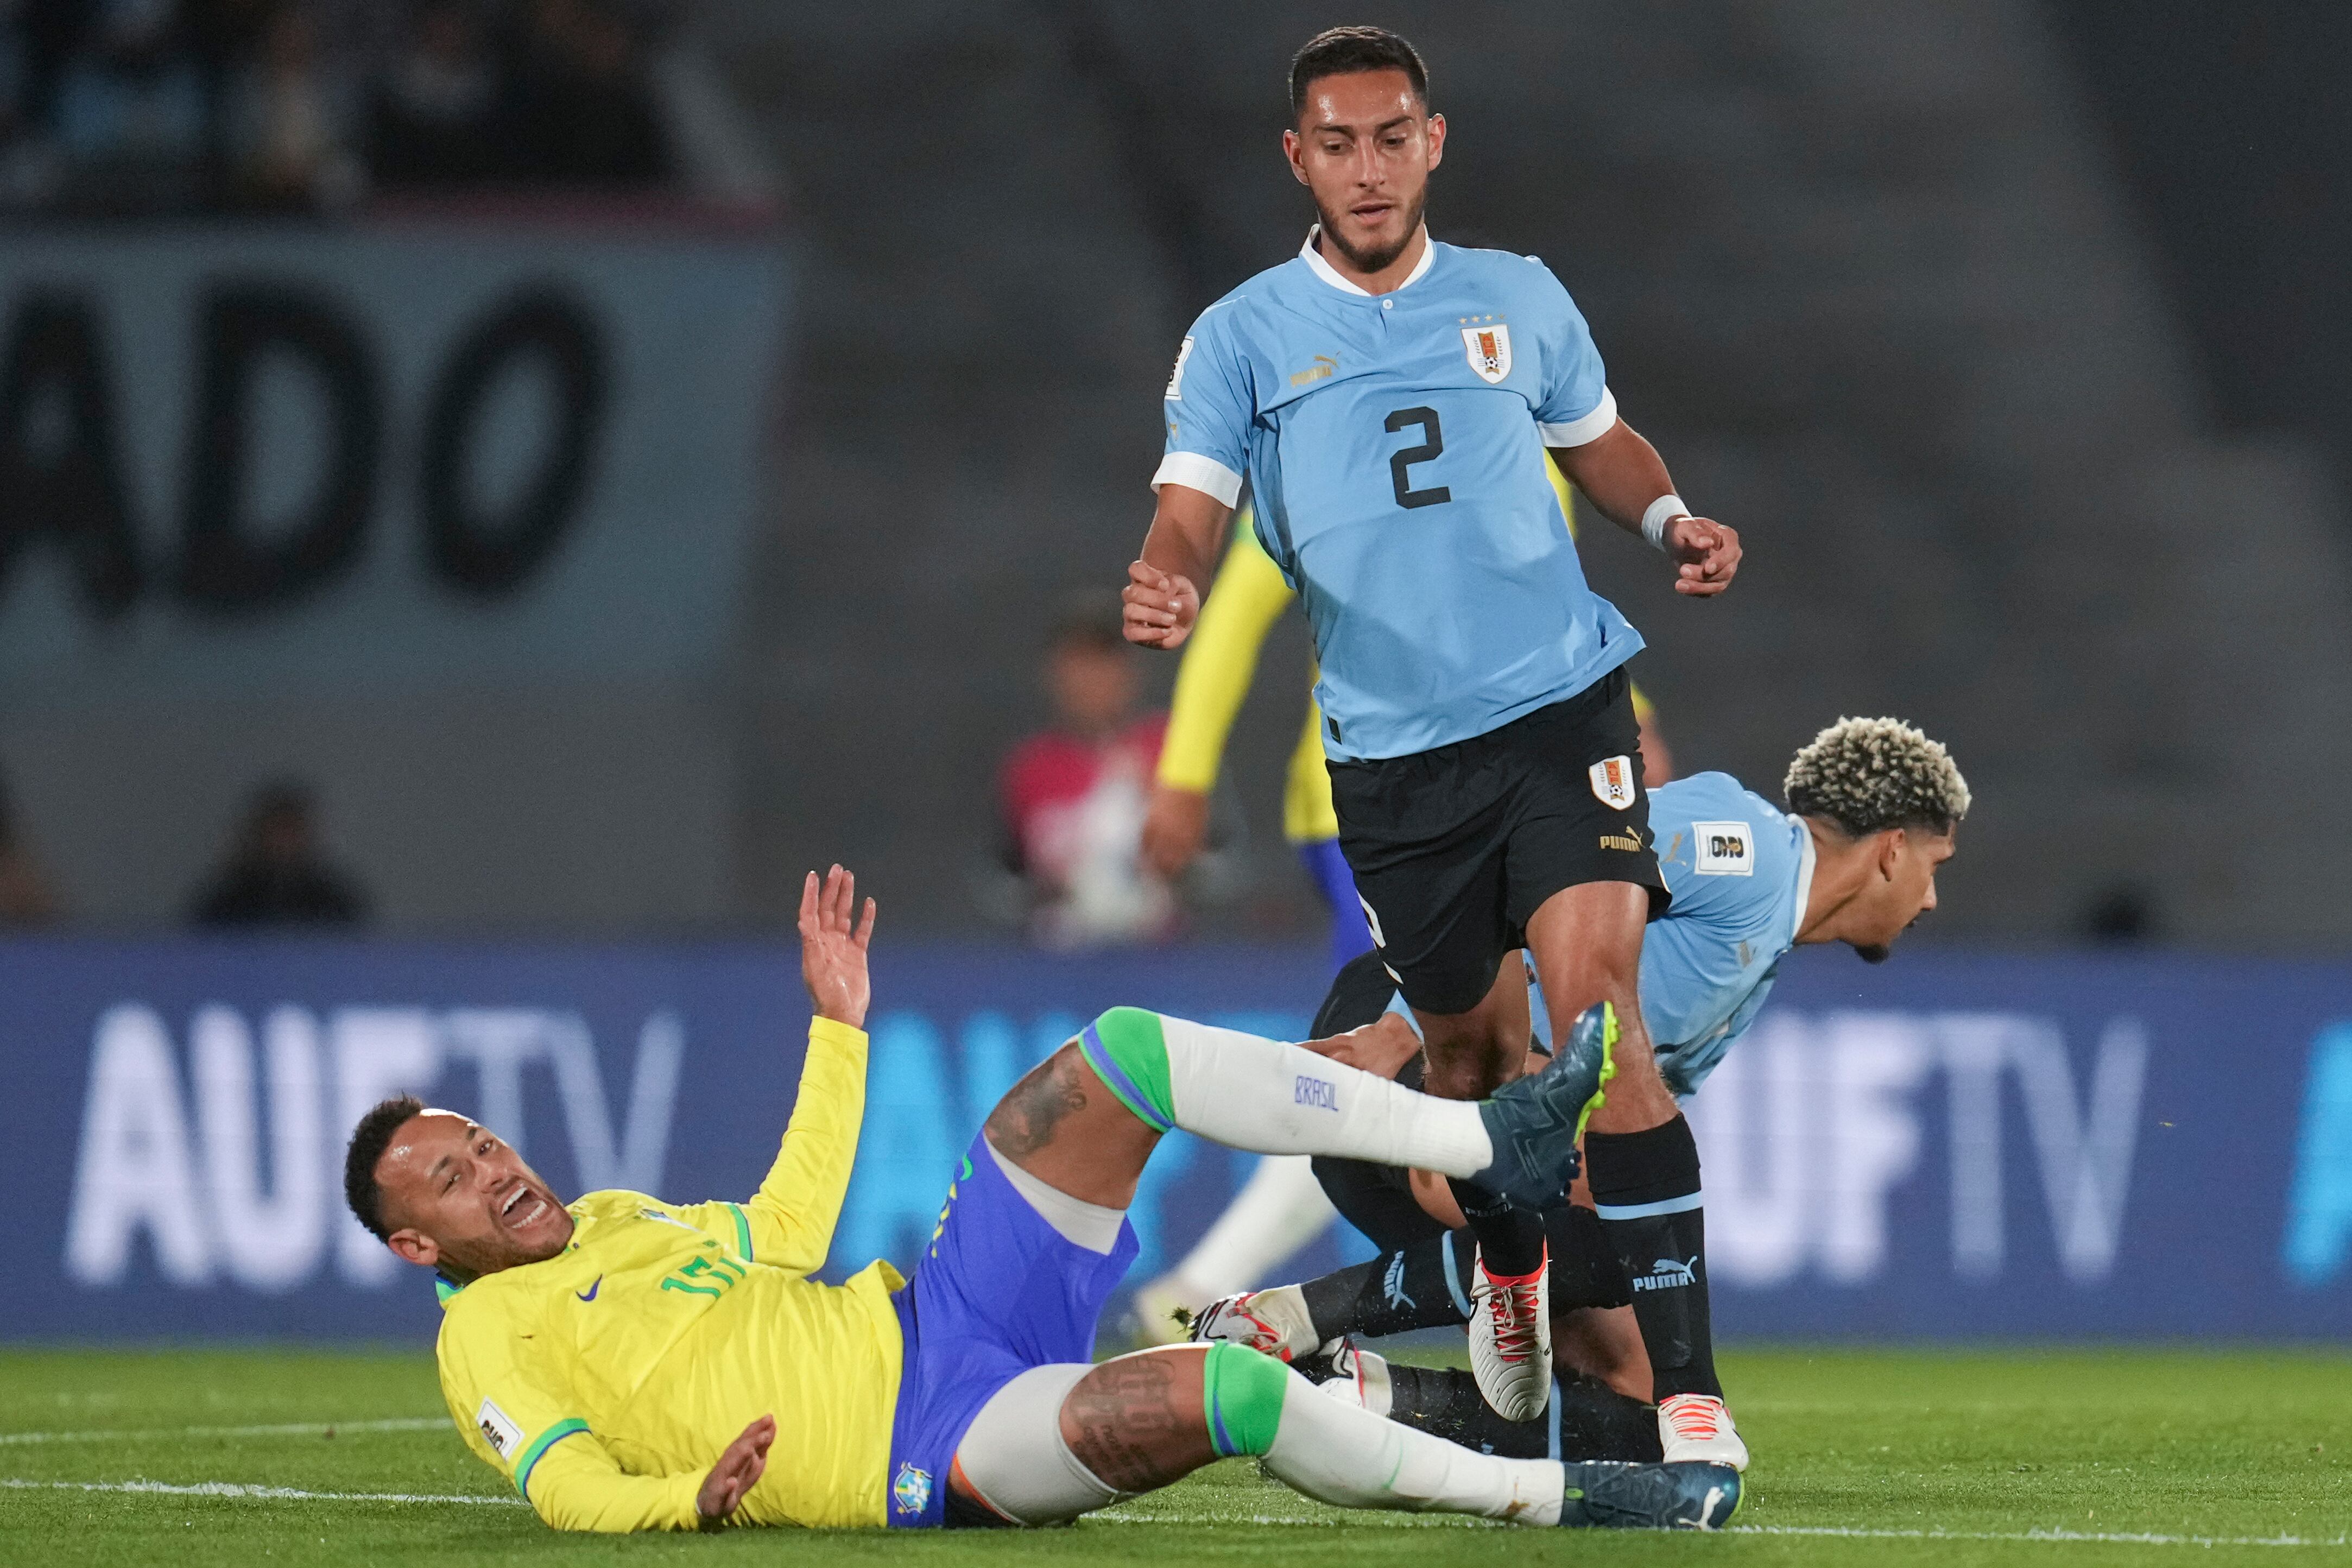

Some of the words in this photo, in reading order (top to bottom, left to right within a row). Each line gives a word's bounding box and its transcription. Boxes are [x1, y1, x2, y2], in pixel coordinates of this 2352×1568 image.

[1384, 406, 1452, 509] 2
[1600, 836, 1641, 852] PUMA
[1295, 1075, 1339, 1112] BRASIL
[1702, 1007, 2153, 1287] UFTV
[1633, 1272, 1690, 1292] PUMA
